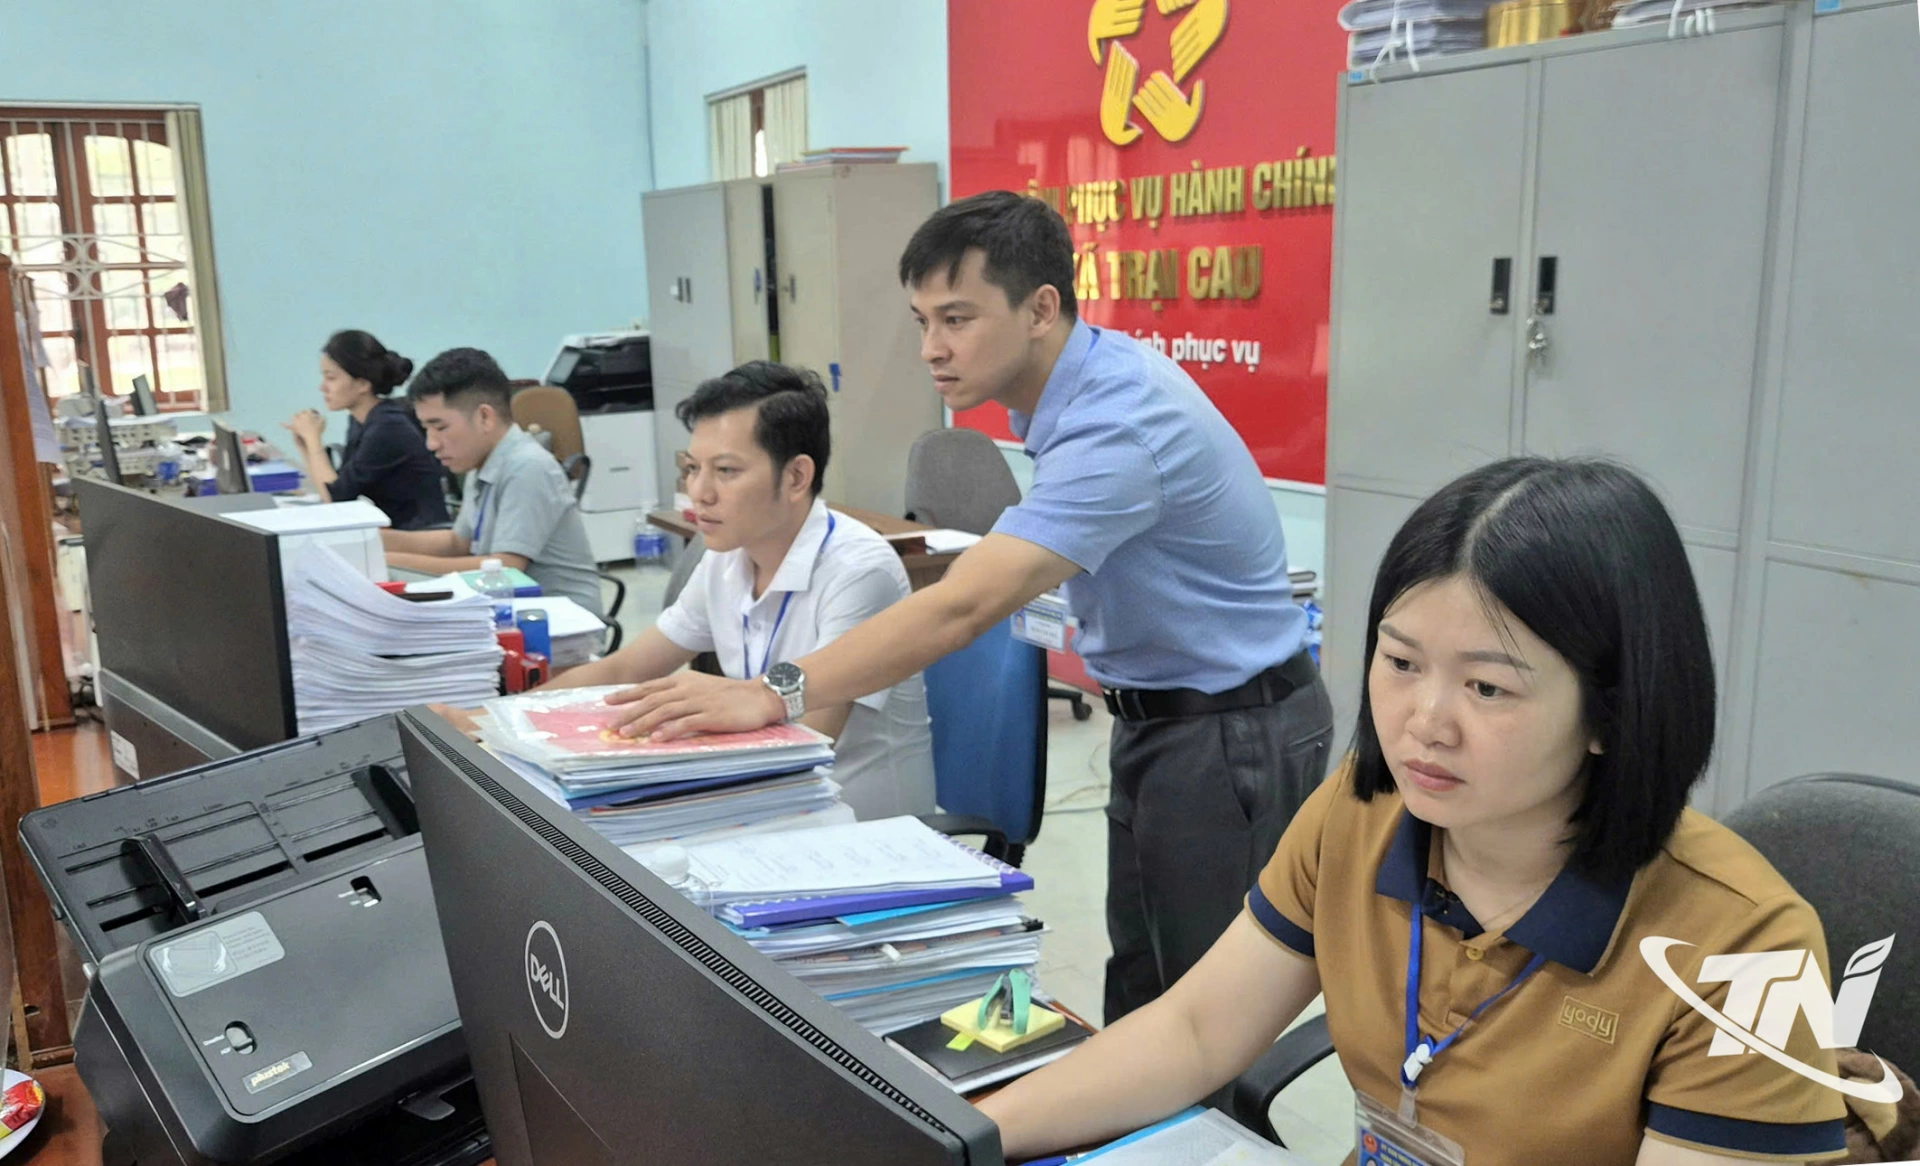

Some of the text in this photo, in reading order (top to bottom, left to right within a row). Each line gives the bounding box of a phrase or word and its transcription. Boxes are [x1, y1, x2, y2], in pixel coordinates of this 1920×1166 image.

[1065, 179, 1126, 232] PHỤC
[1130, 175, 1163, 229] VỤ
[1170, 160, 1245, 217] HÀNH
[1072, 242, 1262, 312] Ã TRẠI CAU
[1171, 331, 1227, 370] phục
[1231, 339, 1260, 373] vụ
[530, 953, 564, 1010] DELL
[1562, 1004, 1612, 1037] yody
[250, 1061, 291, 1087] plustek
